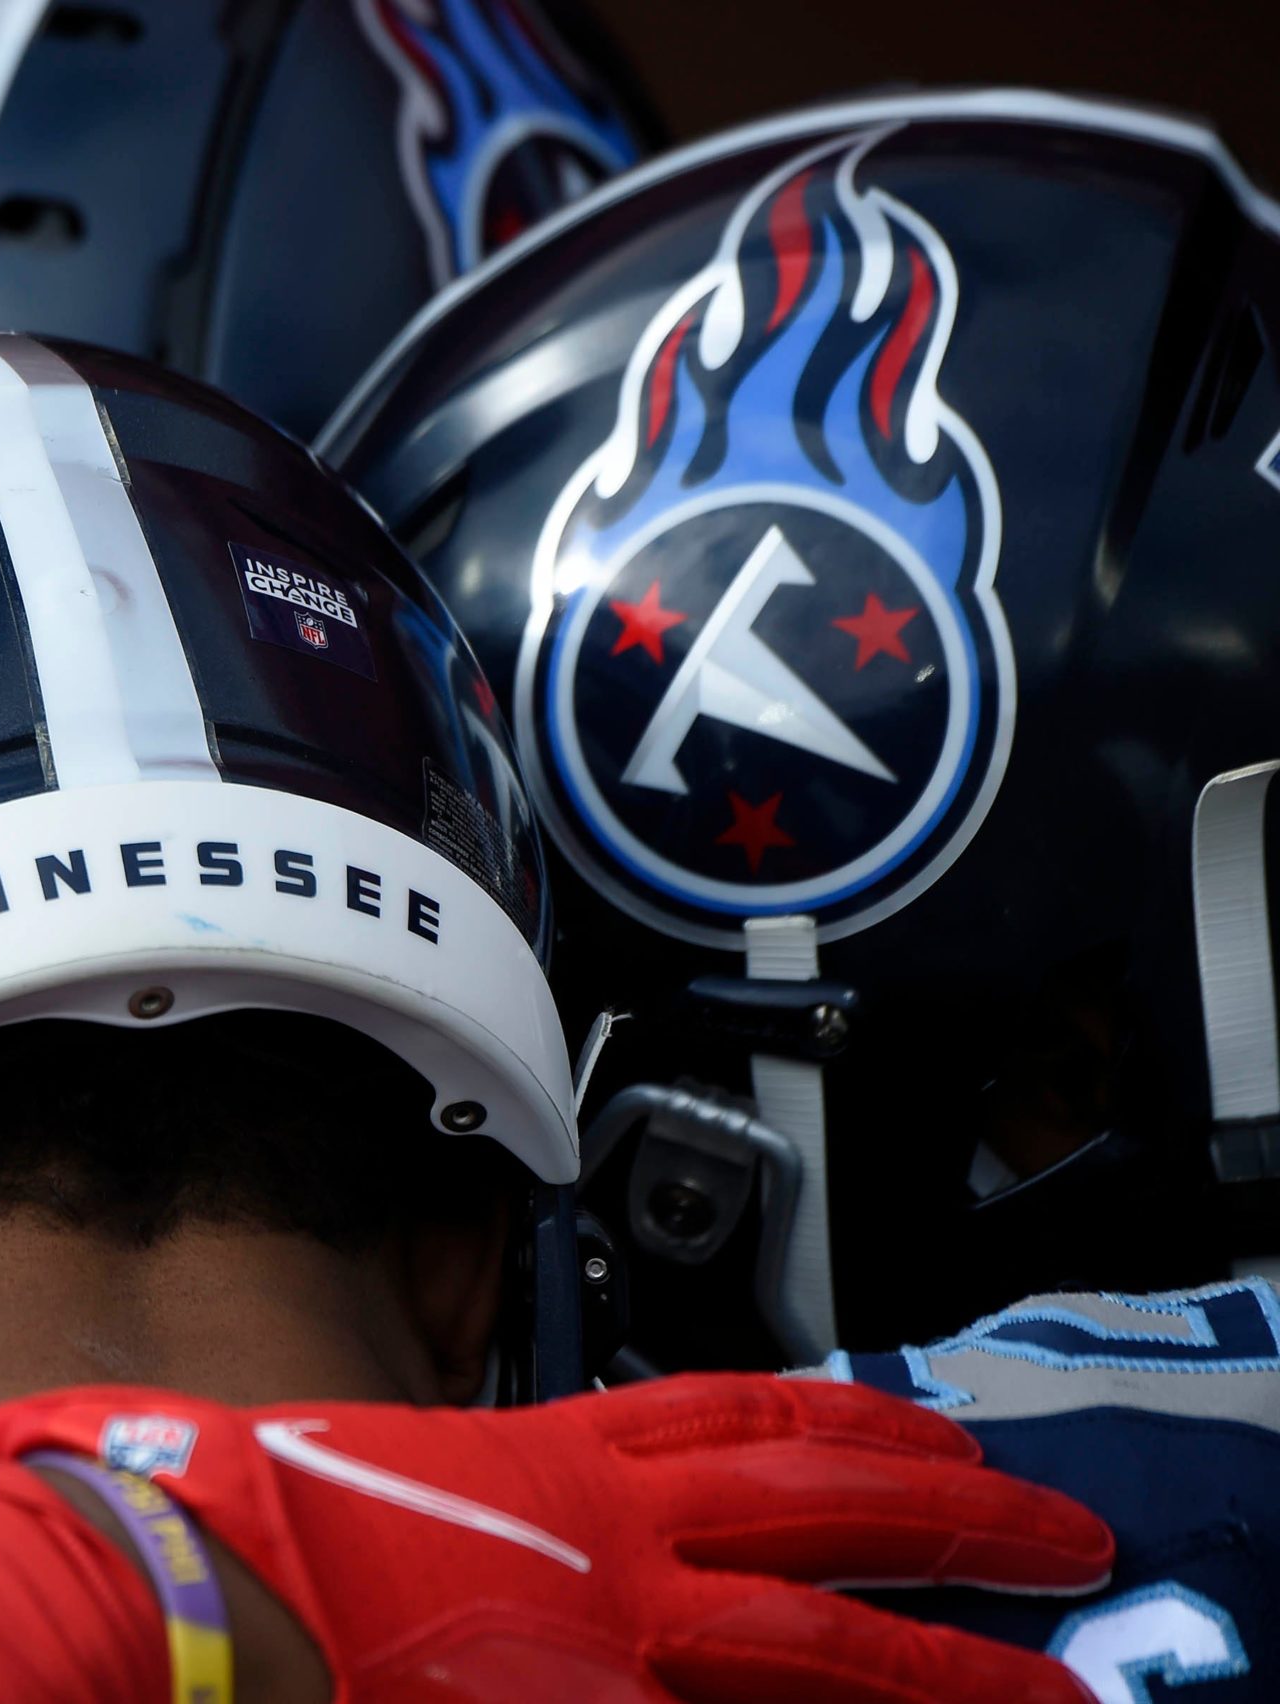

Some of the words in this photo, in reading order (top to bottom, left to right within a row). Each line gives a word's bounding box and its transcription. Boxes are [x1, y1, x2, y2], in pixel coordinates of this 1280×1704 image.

[246, 558, 349, 607] INSPIRE
[249, 575, 355, 625] CHANGE
[300, 624, 326, 645] NFL
